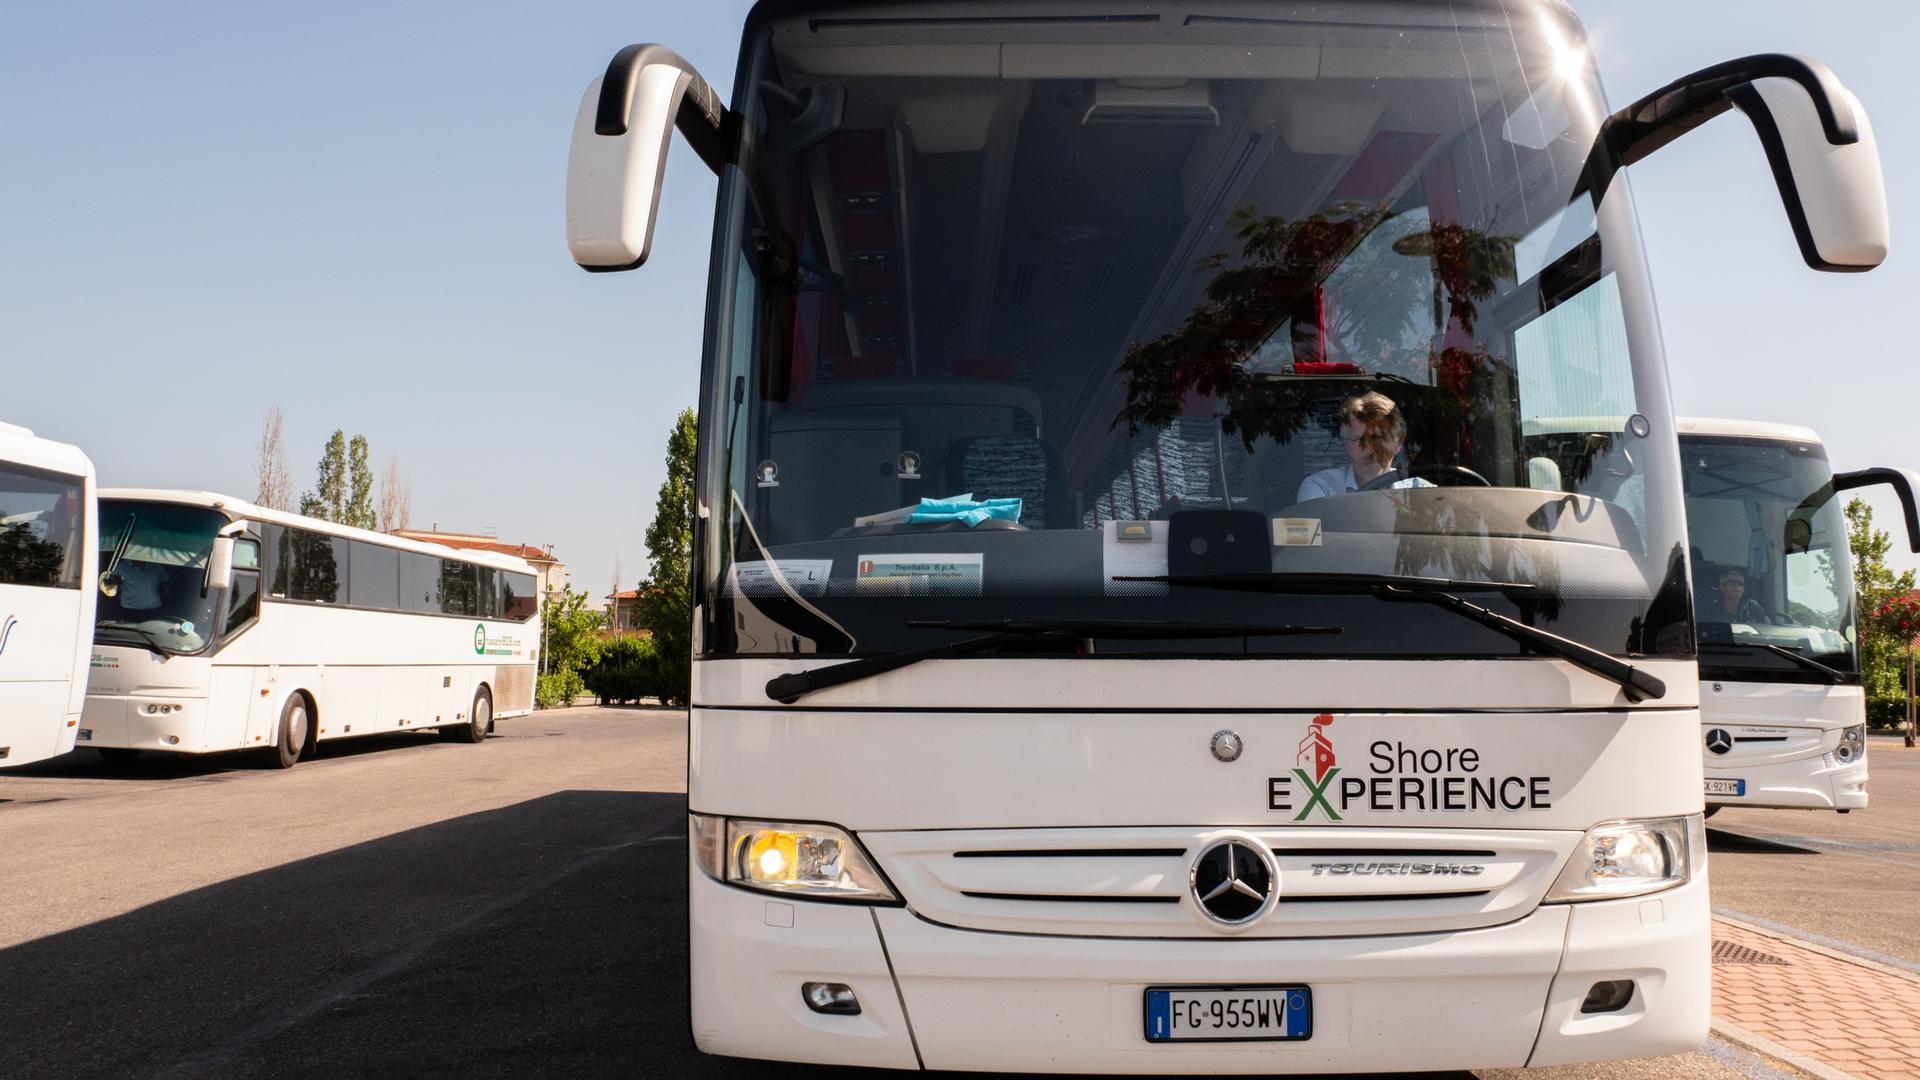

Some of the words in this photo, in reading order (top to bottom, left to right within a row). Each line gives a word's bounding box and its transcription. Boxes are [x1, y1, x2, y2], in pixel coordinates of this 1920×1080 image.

[934, 564, 957, 572] S.p.A.
[1369, 741, 1480, 774] Shore
[1267, 767, 1552, 822] EXPERIENCE
[1311, 863, 1485, 876] TOURISMO
